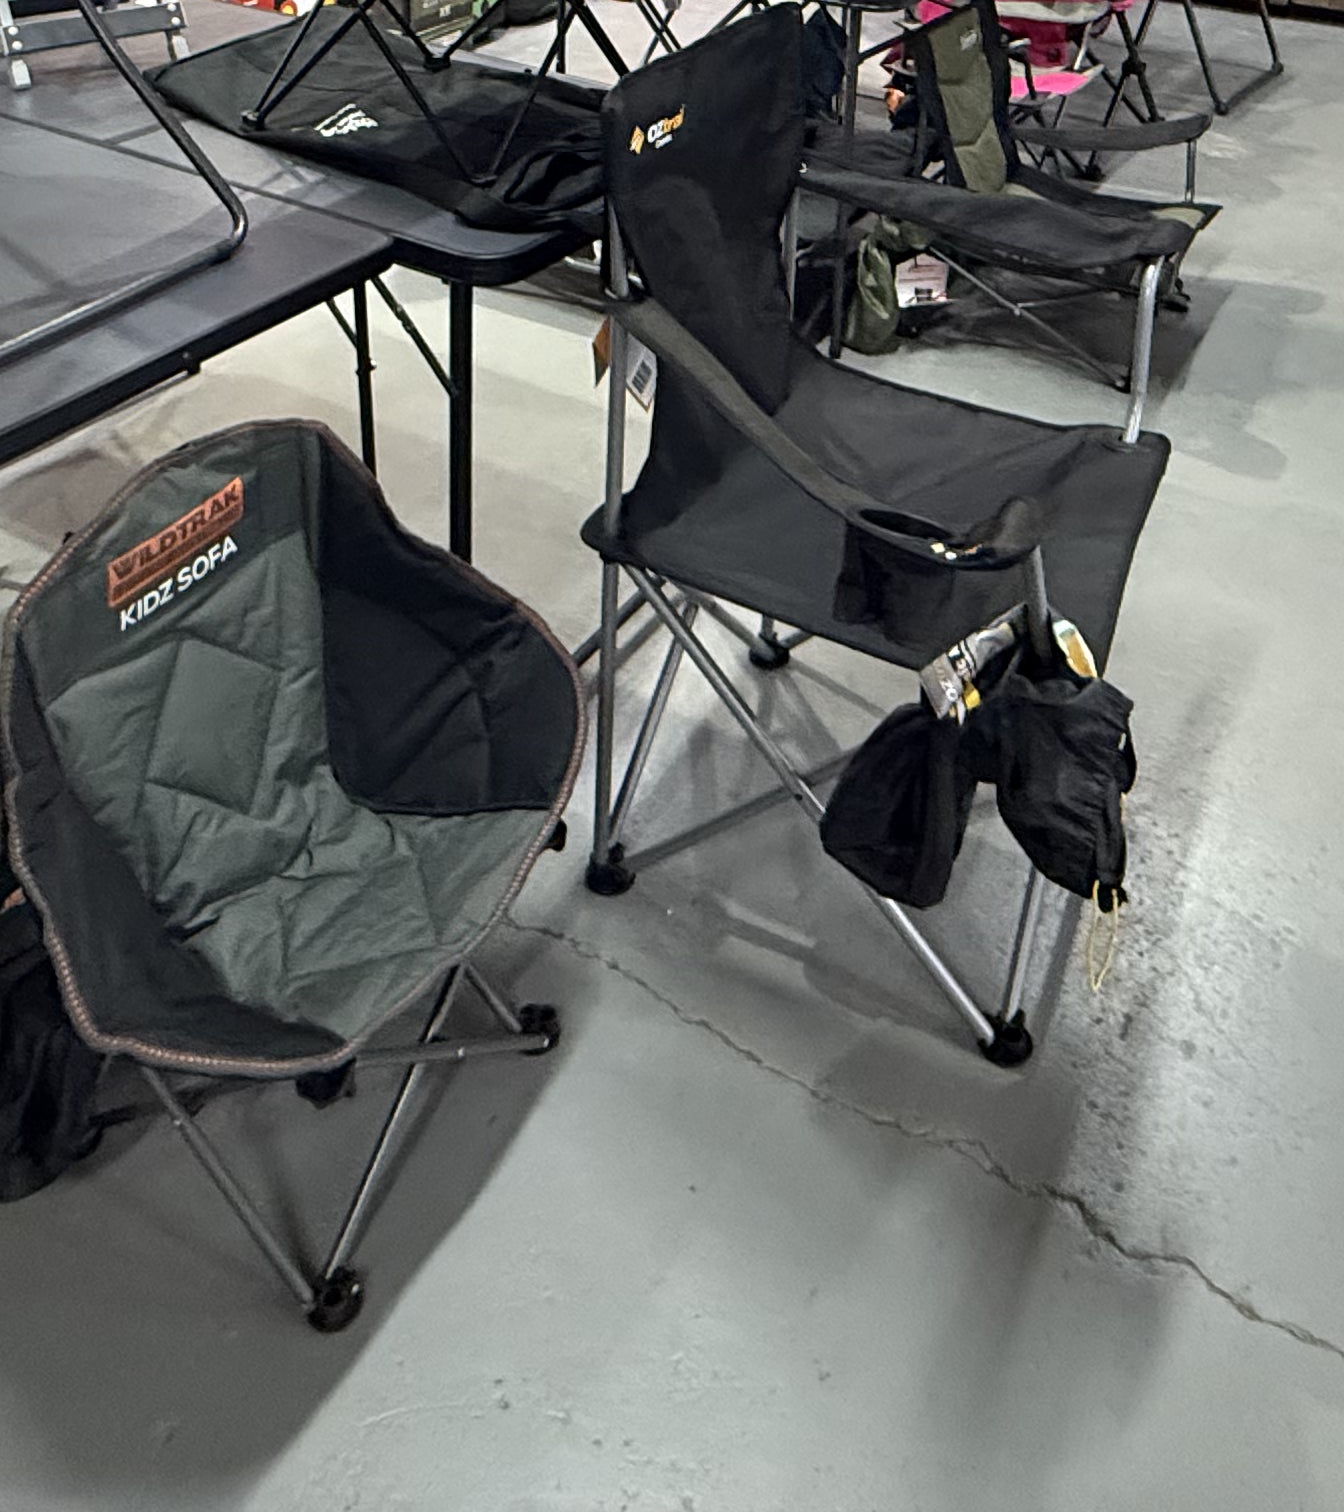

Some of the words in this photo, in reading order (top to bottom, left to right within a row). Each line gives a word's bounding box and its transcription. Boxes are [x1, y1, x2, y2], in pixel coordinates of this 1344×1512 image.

[113, 483, 240, 579] WILDTRAK
[121, 577, 175, 631] KIDZ
[177, 535, 238, 592] SOFA
